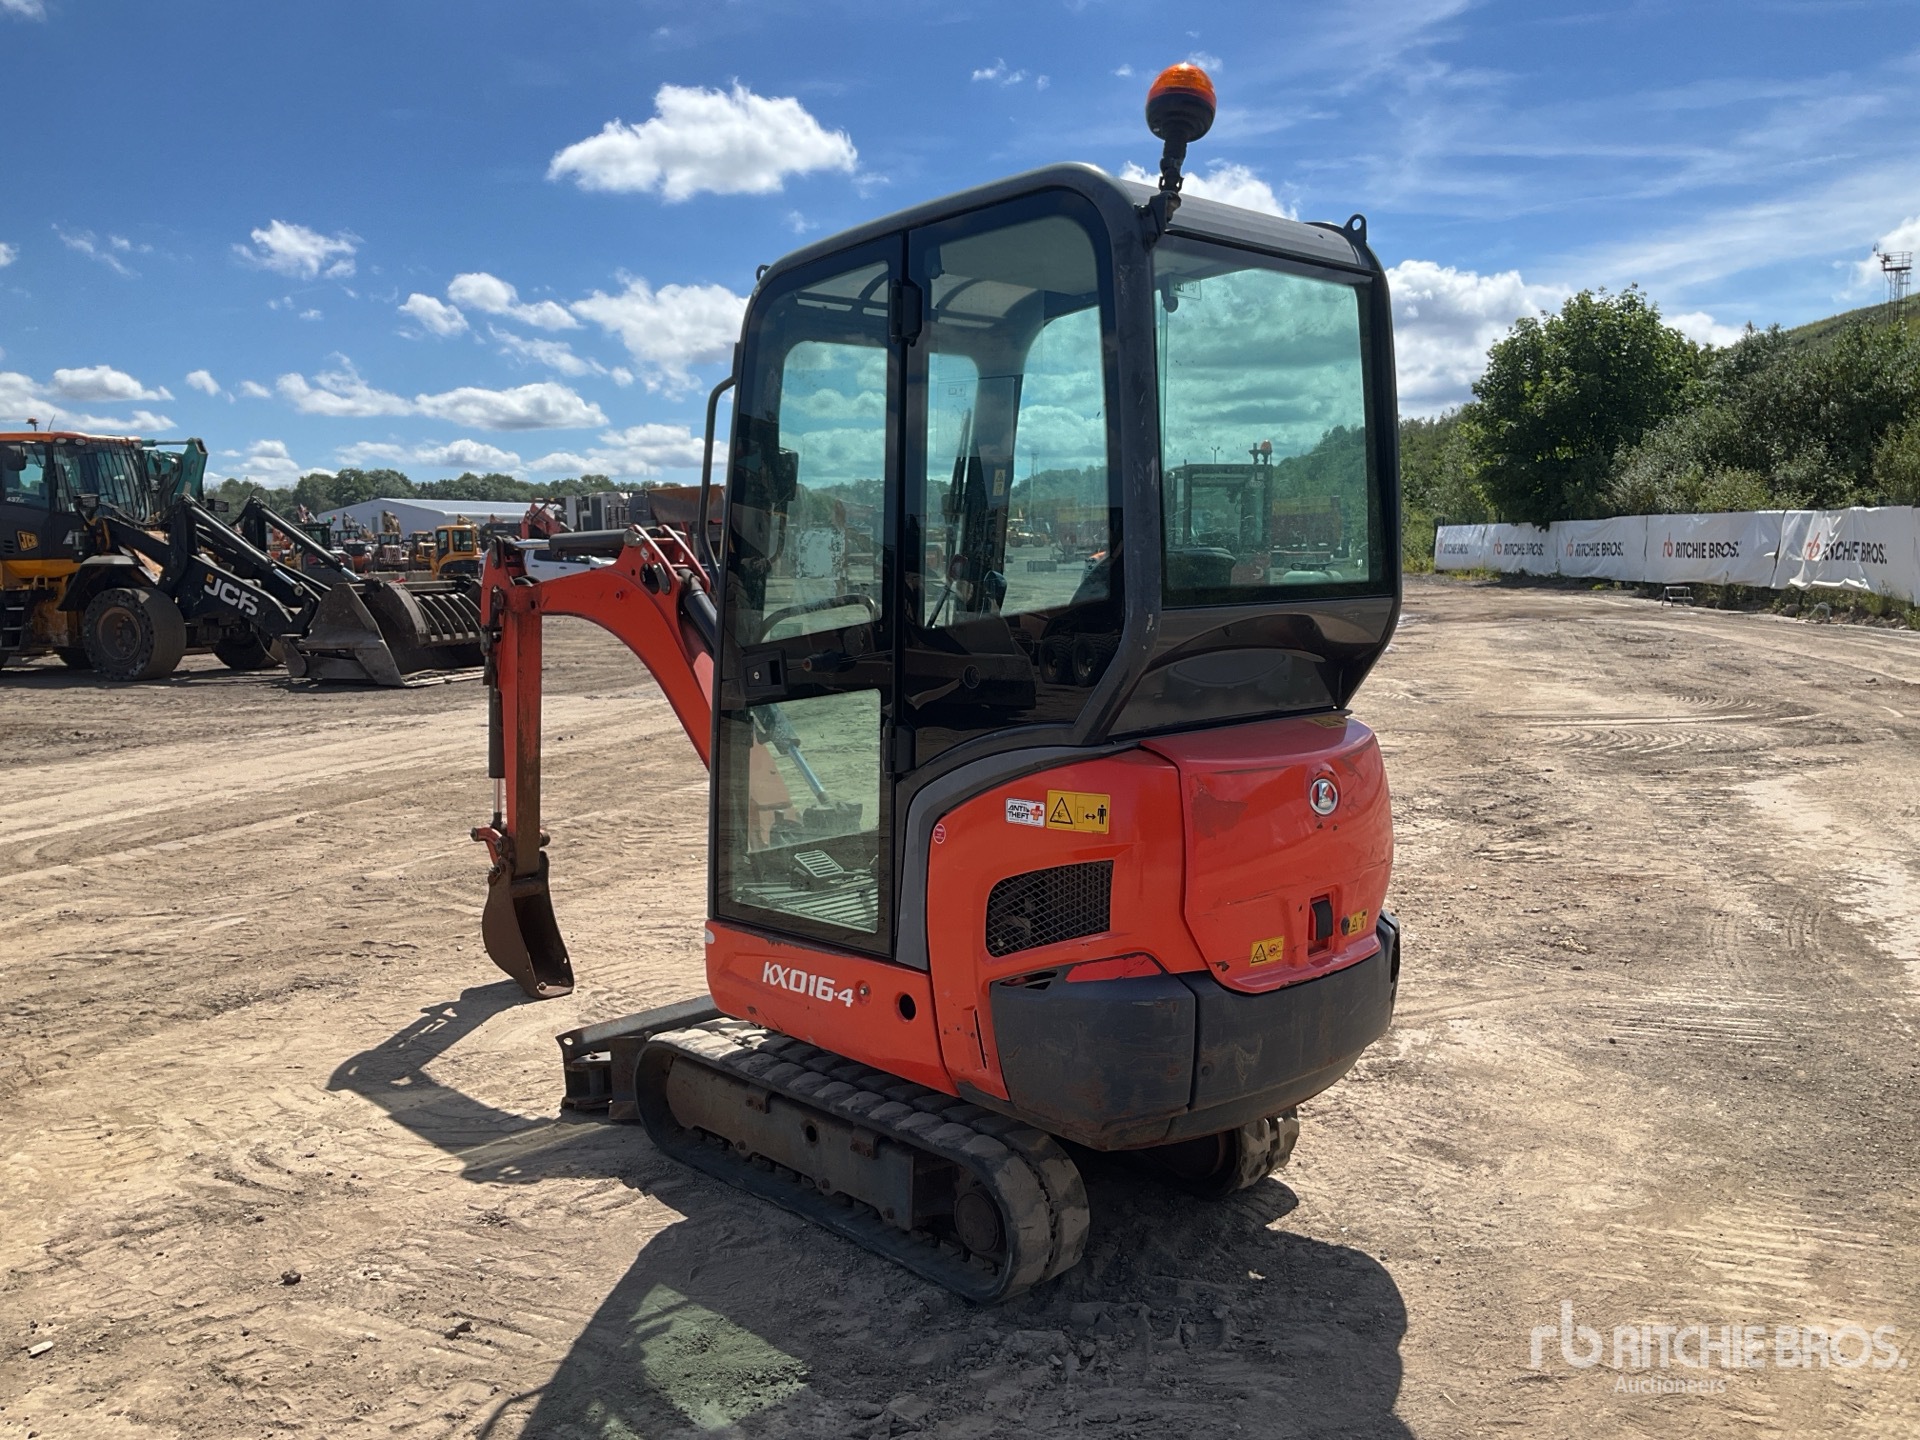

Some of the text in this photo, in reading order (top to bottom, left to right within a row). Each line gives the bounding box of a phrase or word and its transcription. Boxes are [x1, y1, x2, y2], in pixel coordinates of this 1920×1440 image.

[1575, 543, 1600, 557] RITCHIE
[1602, 542, 1623, 556] BROS.
[1676, 542, 1706, 558] RITCHIE
[1709, 541, 1739, 558] BROS.
[1861, 542, 1887, 564] BROS.
[1008, 811, 1030, 819] THEFT
[762, 961, 854, 1007] KX016-4
